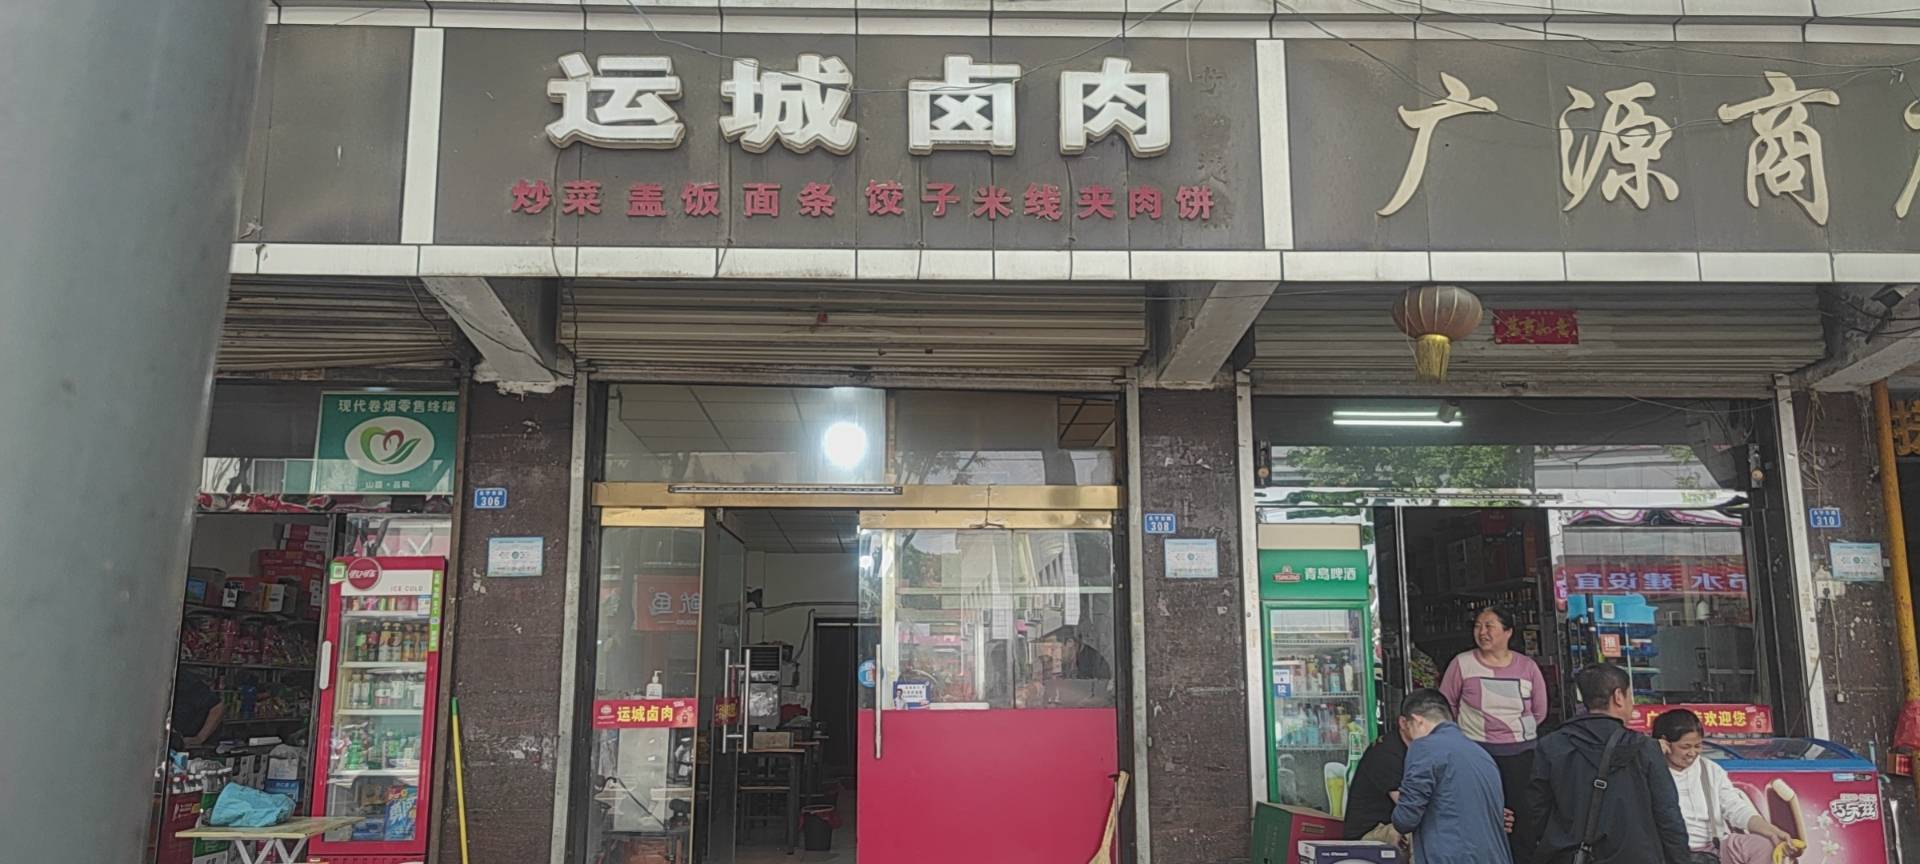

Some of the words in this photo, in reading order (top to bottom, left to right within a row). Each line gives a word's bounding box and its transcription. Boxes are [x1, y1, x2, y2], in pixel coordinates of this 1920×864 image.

[545, 53, 1171, 158] 运城卤肉
[338, 399, 456, 413] 现代卷烟零售终端
[480, 496, 500, 506] 306
[1150, 521, 1170, 532] 308
[1816, 515, 1835, 526] 310
[1304, 567, 1357, 581] 青岛啤酒
[616, 703, 674, 722] 运城卤肉
[1646, 710, 1747, 727] 广欢迎您
